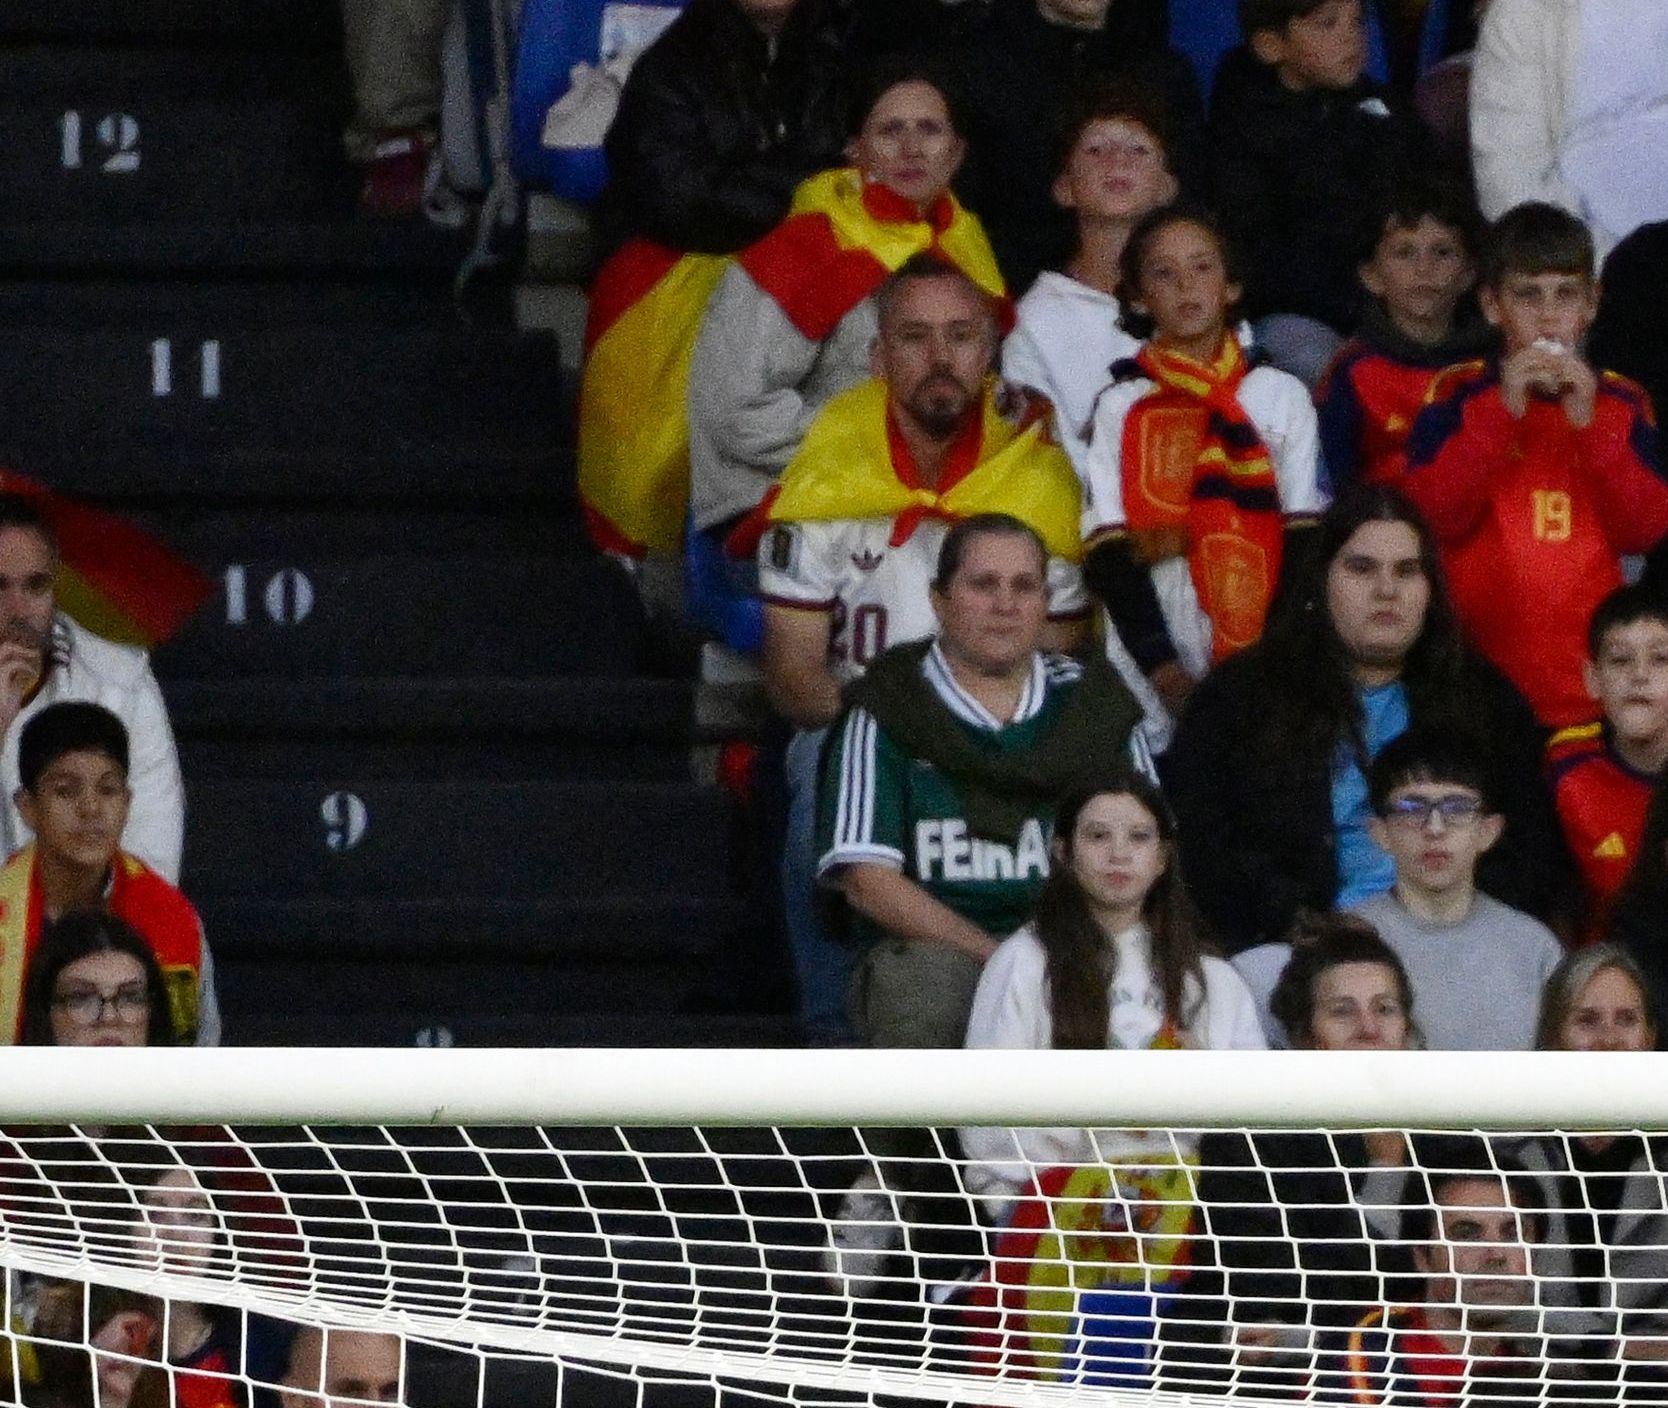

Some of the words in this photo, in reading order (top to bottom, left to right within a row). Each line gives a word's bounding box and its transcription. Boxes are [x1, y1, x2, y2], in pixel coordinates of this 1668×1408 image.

[57, 109, 142, 172] 12
[152, 338, 221, 398] 11
[1533, 489, 1571, 541] 19
[224, 564, 315, 625] 10
[320, 791, 368, 851] 9
